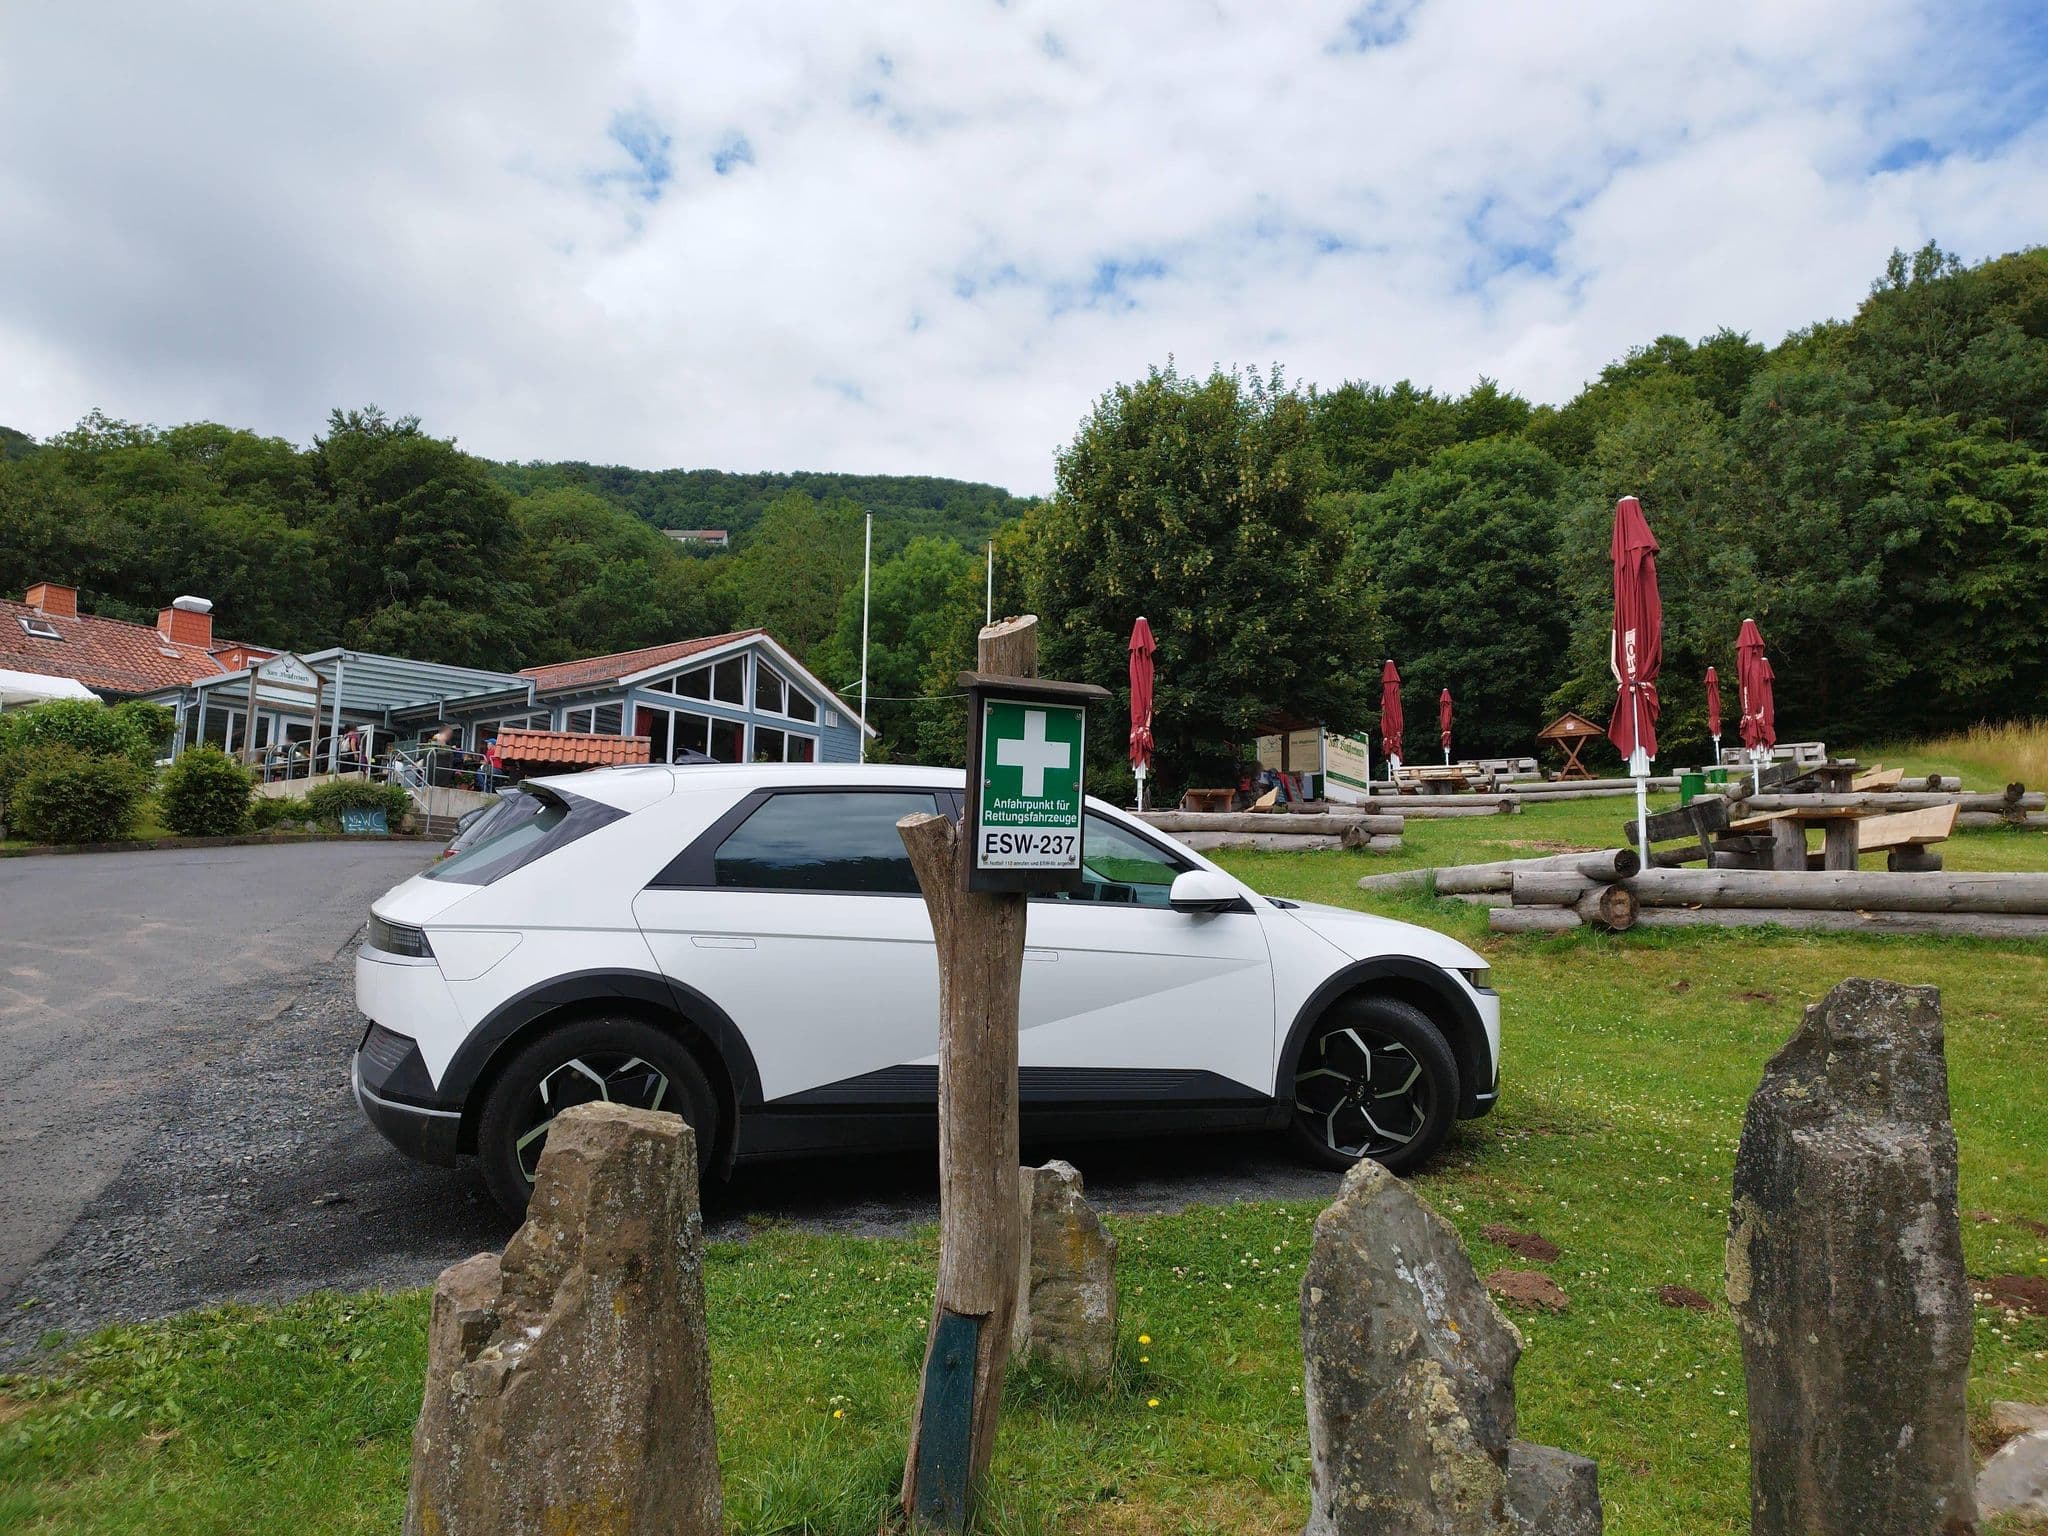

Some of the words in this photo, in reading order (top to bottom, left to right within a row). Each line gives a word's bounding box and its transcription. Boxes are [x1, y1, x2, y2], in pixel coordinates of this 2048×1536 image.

[993, 798, 1054, 812] Anfahrpunkt
[1056, 799, 1070, 811] für
[360, 812, 384, 827] WC
[985, 810, 1077, 824] Rettungsfahrzeuge
[985, 834, 1075, 854] ESW-237
